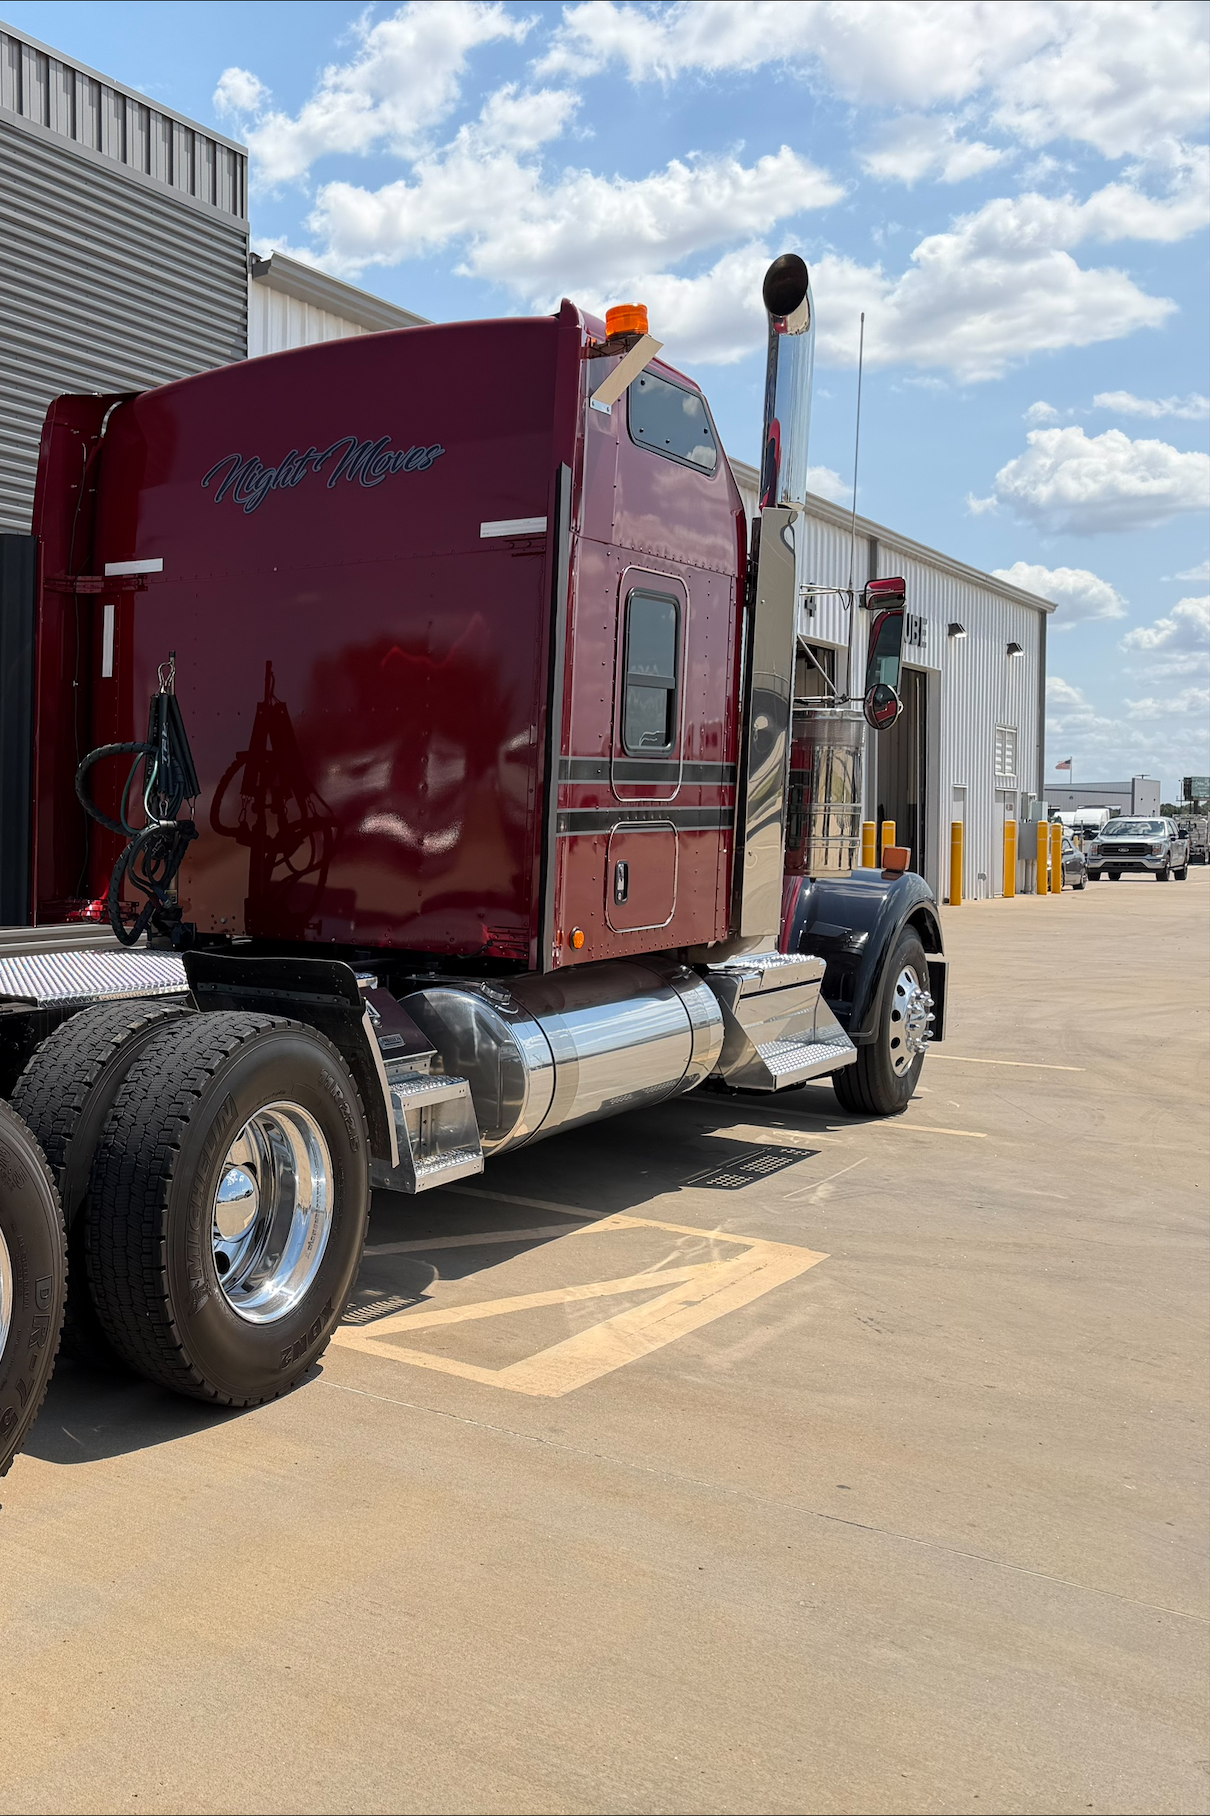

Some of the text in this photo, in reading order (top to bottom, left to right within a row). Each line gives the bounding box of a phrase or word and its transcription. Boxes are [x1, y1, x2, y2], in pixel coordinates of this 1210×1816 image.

[201, 435, 445, 514] Night Moves
[904, 612, 928, 649] UBE
[187, 1093, 238, 1277] MICHELIN
